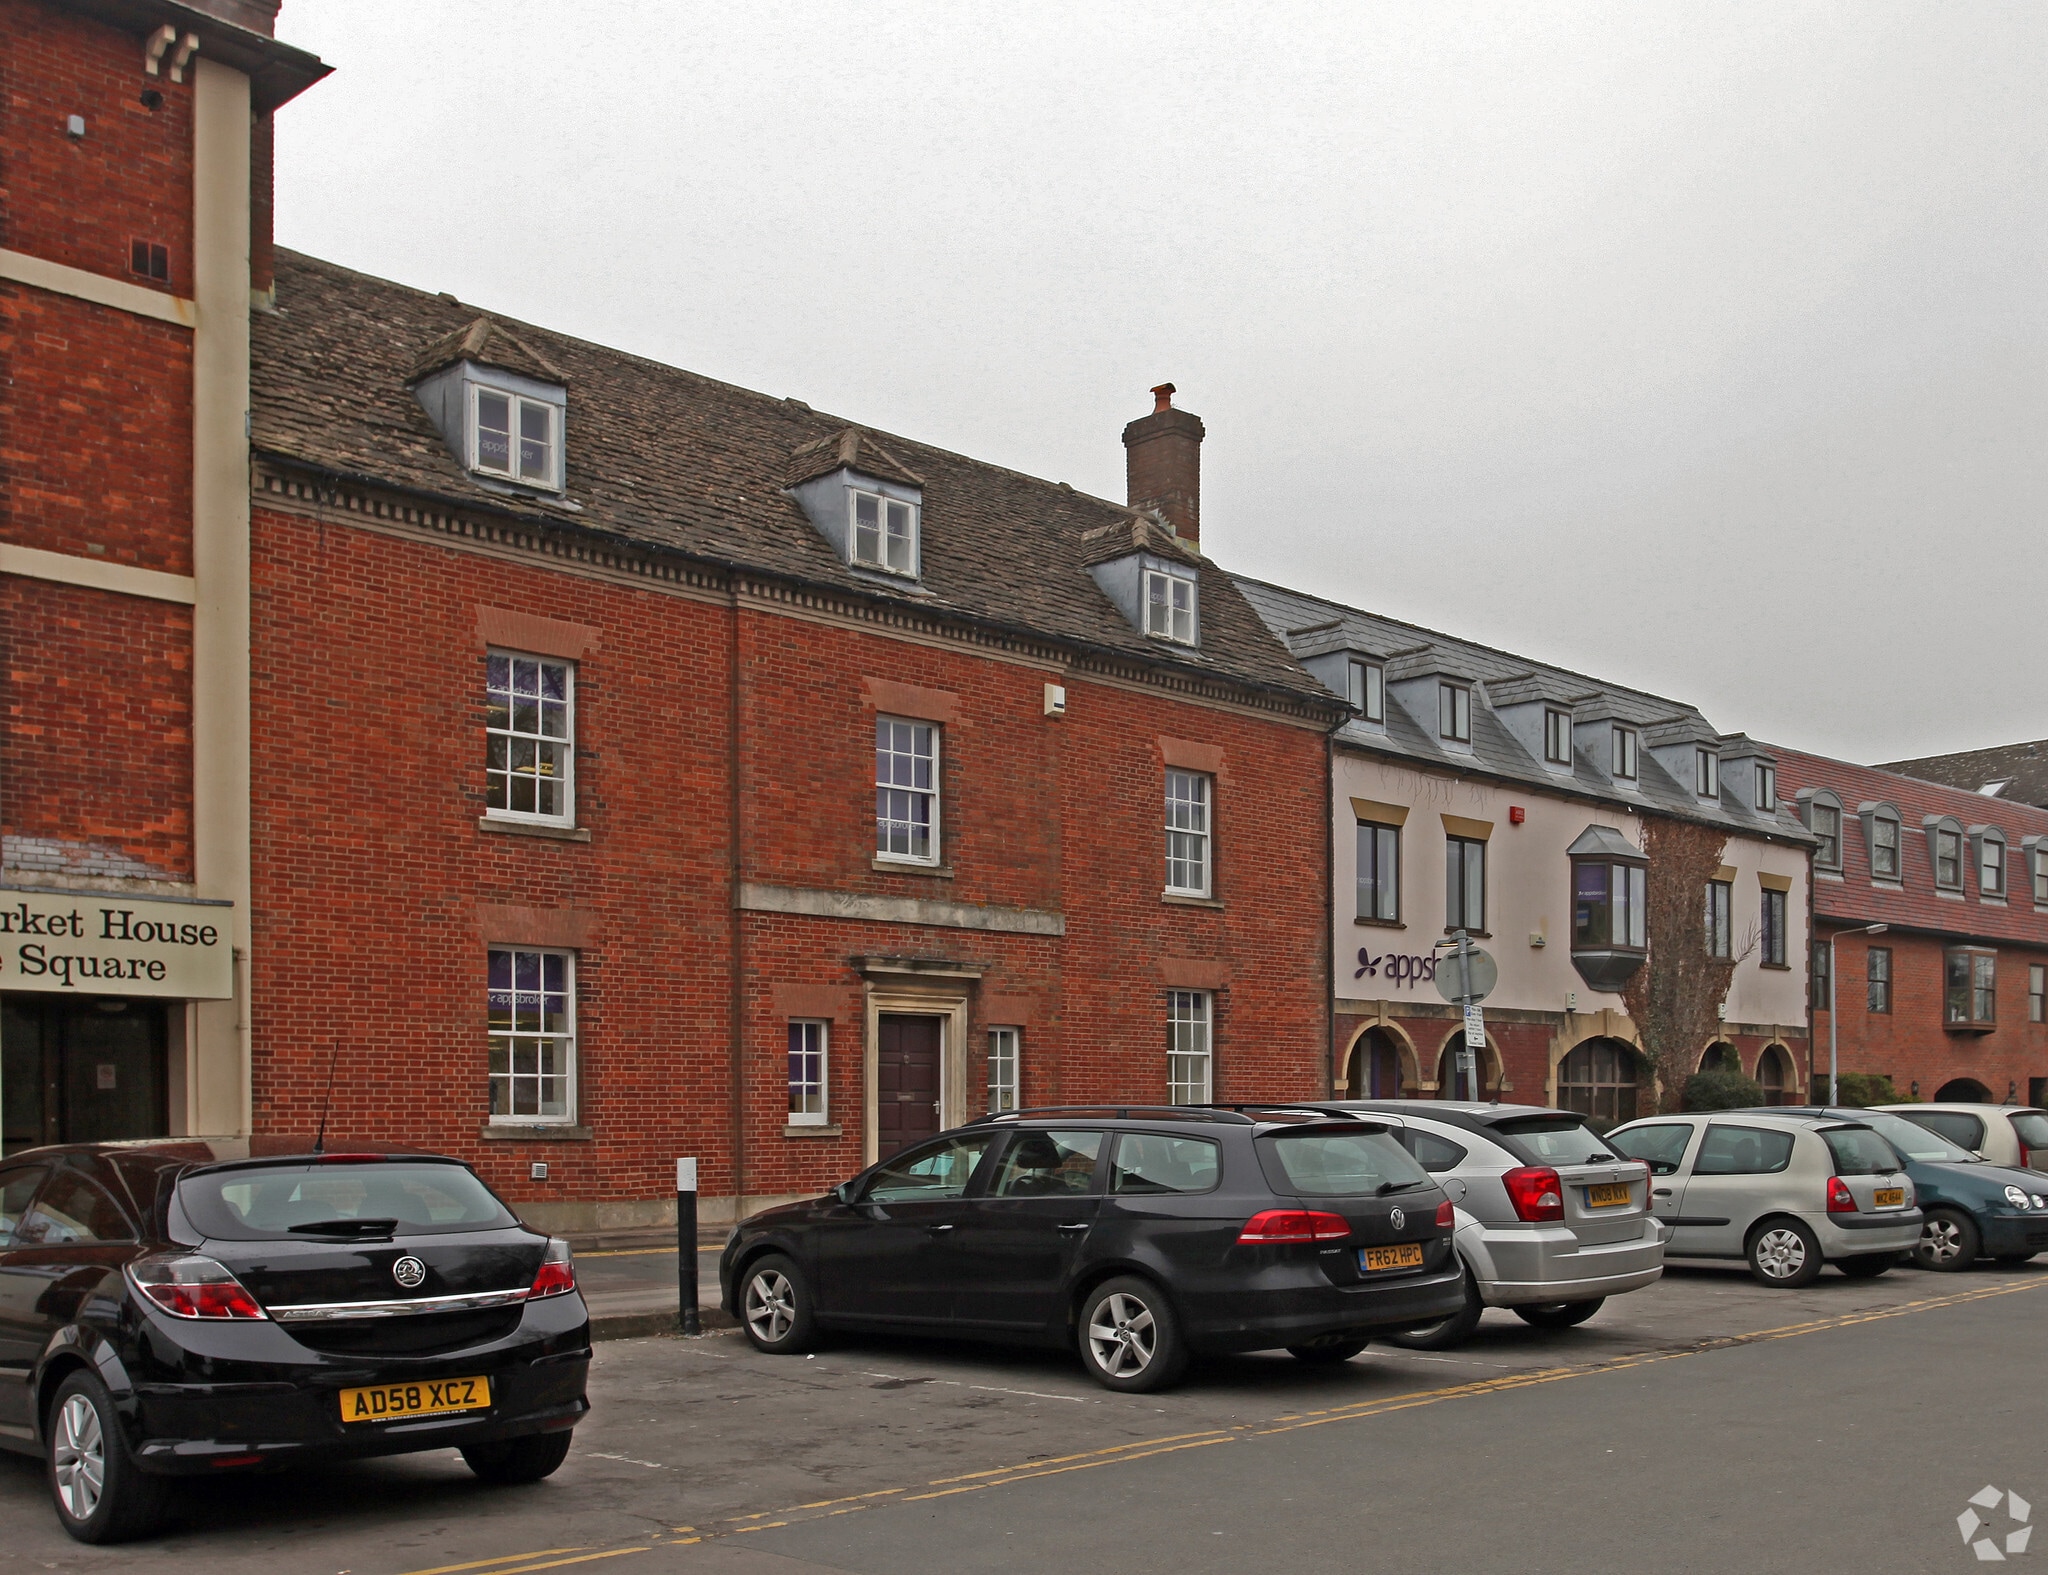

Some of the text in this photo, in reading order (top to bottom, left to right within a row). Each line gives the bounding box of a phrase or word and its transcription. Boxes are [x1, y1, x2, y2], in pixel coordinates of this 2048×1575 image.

[99, 908, 218, 947] House
[19, 944, 166, 987] Square
[497, 993, 550, 1006] appsbrokr
[1367, 1246, 1421, 1267] FR62 HPC
[283, 1310, 323, 1318] ASTRA
[354, 1380, 477, 1416] AD58 XCZ
